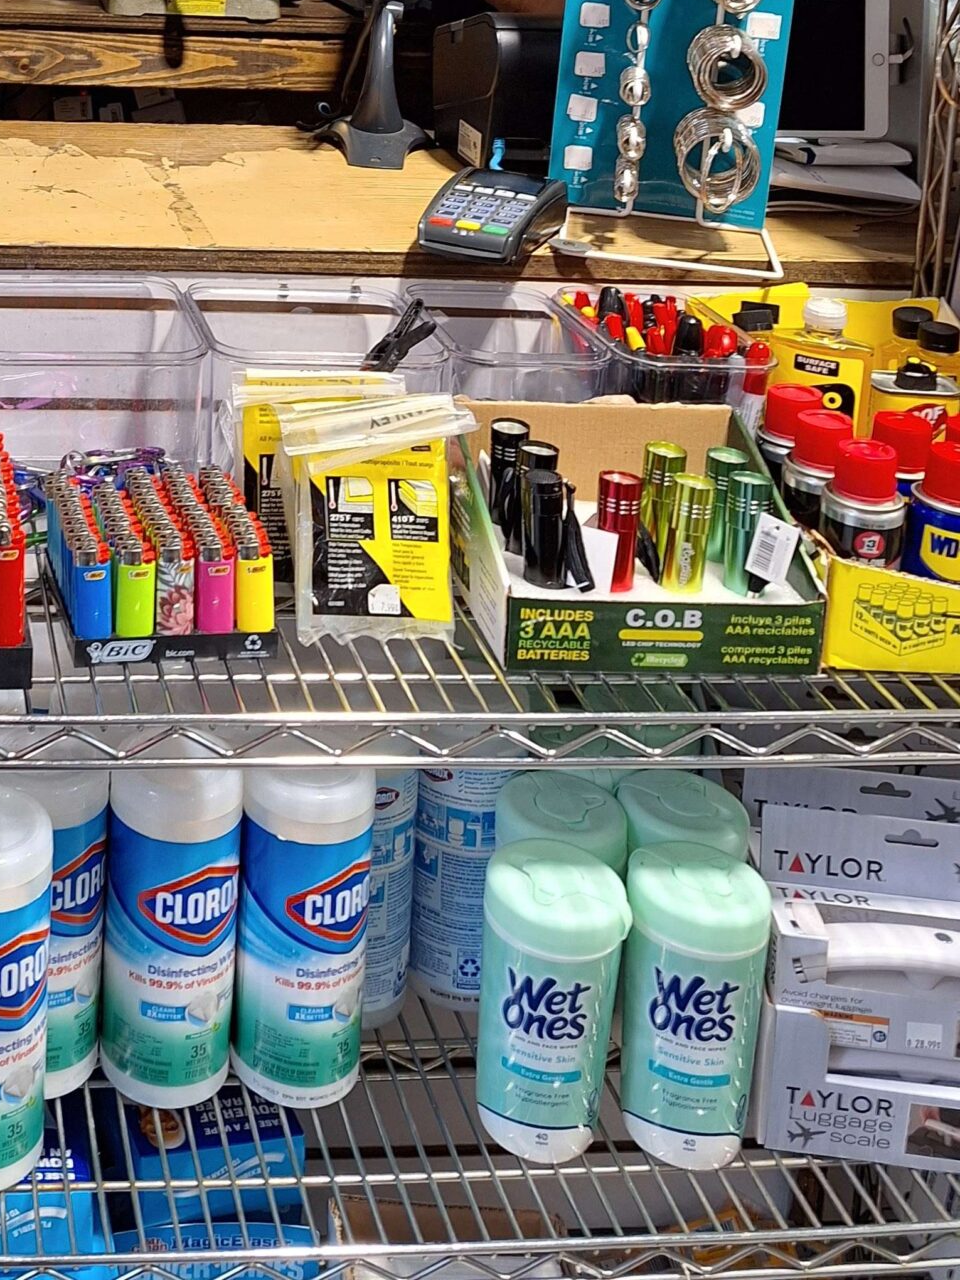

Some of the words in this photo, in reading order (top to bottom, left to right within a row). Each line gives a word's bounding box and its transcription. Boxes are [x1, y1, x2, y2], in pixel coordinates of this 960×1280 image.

[797, 355, 837, 370] SURFACE
[805, 364, 829, 375] SAFE
[519, 607, 594, 622] INCLUDES
[625, 608, 703, 628] C.O.B
[731, 614, 772, 626] incluye
[775, 615, 782, 624] 3
[784, 615, 812, 627] pilas
[519, 621, 535, 638] 3
[540, 621, 591, 639] AAA
[725, 626, 751, 635] AAA
[753, 626, 816, 636] reciclables
[106, 640, 153, 662] BIC
[165, 648, 195, 657] bic.com
[518, 639, 591, 650] RECYCLABLE
[654, 641, 701, 649] TECHNOLOGY
[721, 645, 776, 657] comprend
[778, 646, 784, 655] 3
[787, 646, 813, 657] piles
[517, 649, 590, 661] BATTERIES
[723, 656, 746, 664] AAA
[748, 656, 810, 666] recyclables
[773, 848, 885, 882] TAYLOR
[776, 886, 871, 907] TAYLOR
[147, 960, 218, 980] Disinfecting
[296, 956, 360, 979] Disinfecting
[128, 970, 147, 986] Kills
[148, 977, 183, 990] 99.9%
[184, 977, 196, 990] of
[274, 975, 296, 989] Kills
[297, 979, 332, 991] 99.9%
[507, 966, 592, 1016] Wet
[654, 966, 740, 1016] Wet
[781, 987, 808, 999] Avoid
[810, 990, 848, 1005] charges
[850, 995, 865, 1005] for
[780, 996, 834, 1011] overweight
[501, 996, 589, 1042] Ones
[648, 996, 737, 1043] Ones
[190, 1041, 207, 1059] 35
[510, 1043, 554, 1064] Sensitive
[555, 1054, 577, 1064] Skin
[657, 1045, 702, 1067] Sensitive
[703, 1056, 726, 1067] Skin
[0, 1055, 10, 1067] of
[785, 1085, 895, 1119] TAYLOR
[789, 1105, 894, 1133] Luggage
[6, 1120, 24, 1139] 35
[829, 1129, 891, 1151] scale
